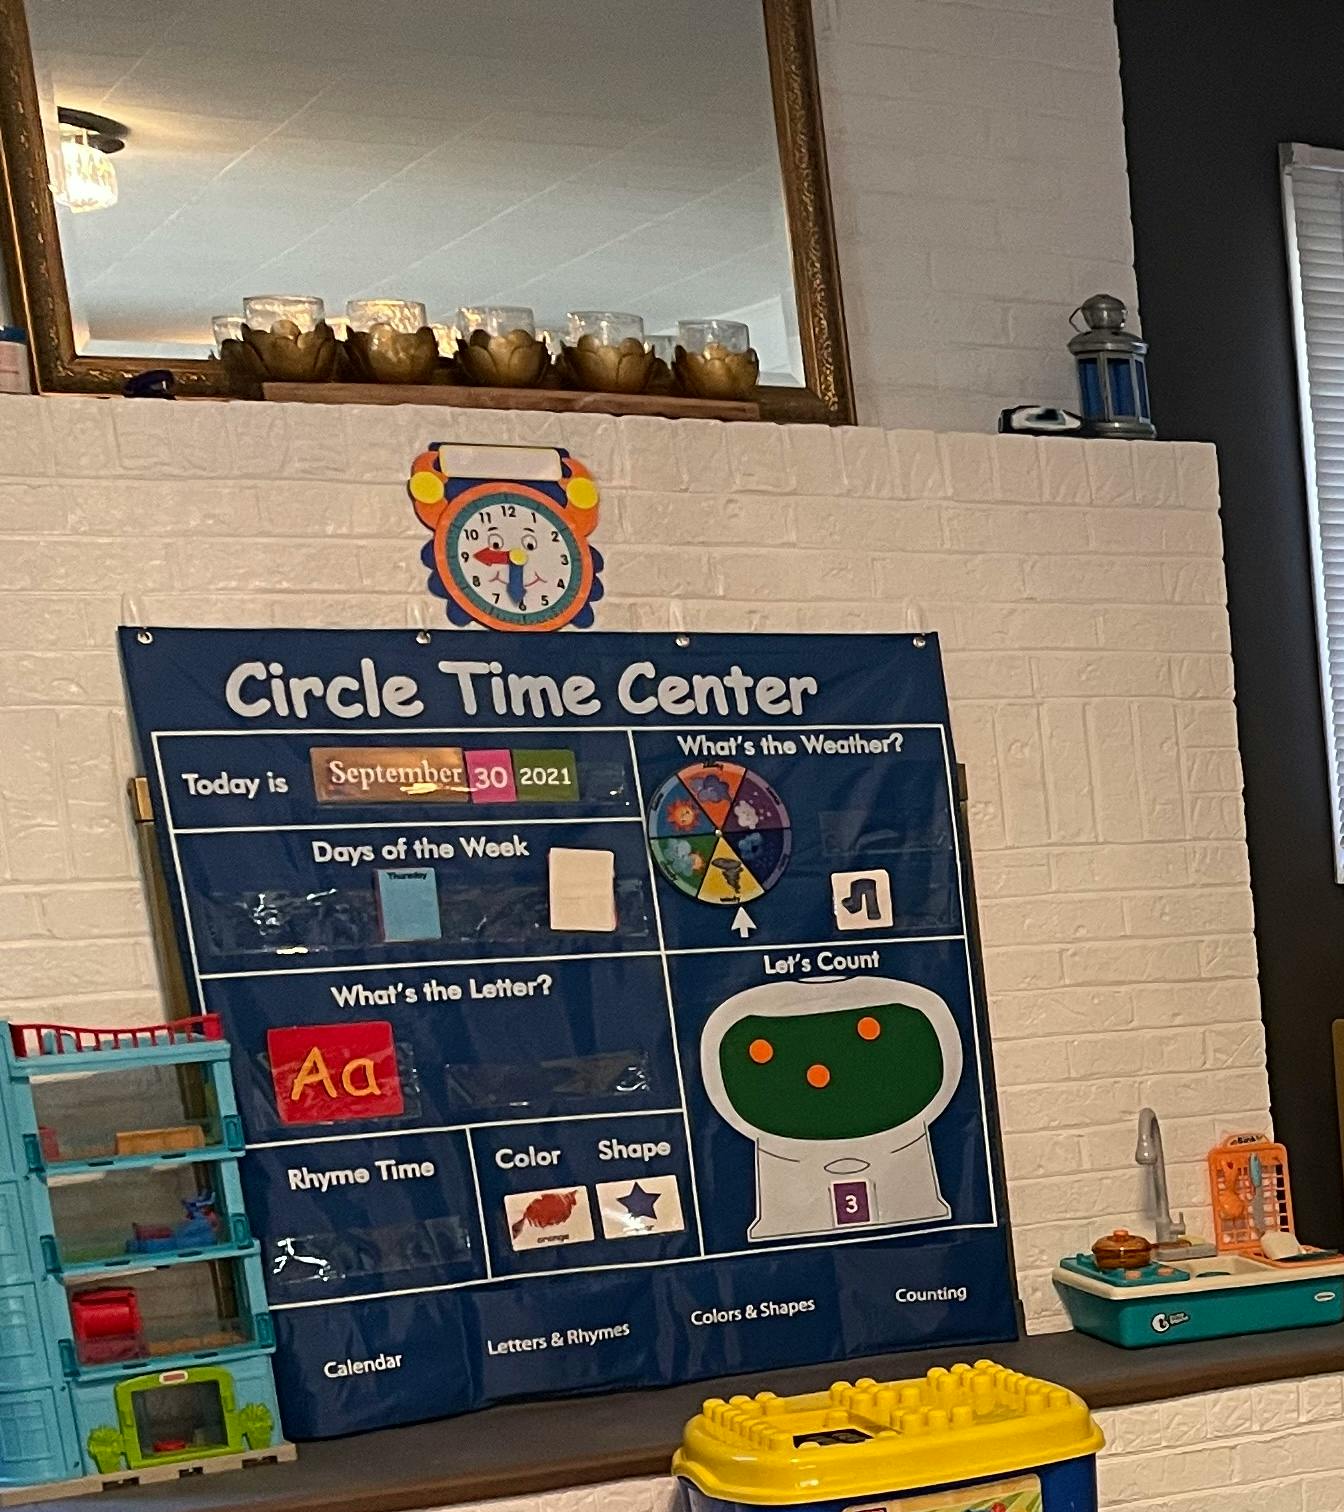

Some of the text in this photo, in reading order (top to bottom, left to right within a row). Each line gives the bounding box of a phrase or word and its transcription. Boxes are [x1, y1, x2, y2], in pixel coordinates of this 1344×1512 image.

[479, 512, 492, 524] 11
[501, 505, 516, 518] 12
[531, 512, 537, 523] 1
[463, 529, 479, 541] 10
[551, 530, 560, 542] 2
[461, 551, 469, 562] 9
[560, 554, 569, 565] 3
[472, 575, 481, 587] 8
[556, 578, 565, 589] 4
[491, 593, 500, 604] 7
[518, 597, 527, 611] 6
[540, 595, 549, 606] 5
[225, 658, 818, 718] Circle Time Center
[676, 733, 904, 756] What's the Weather?
[181, 771, 289, 799] Today is
[328, 760, 462, 790] September
[473, 766, 508, 789] 30
[519, 766, 572, 786] 2021
[311, 835, 529, 866] Days of the Week
[763, 950, 880, 975] Let's Count
[330, 974, 552, 1007] What's the Letter?
[291, 1046, 382, 1100] Aa
[495, 1139, 672, 1169] Color Shape
[287, 1159, 435, 1193] Rhyme Time
[845, 1194, 859, 1214] 3
[895, 1286, 968, 1303] Counting
[690, 1298, 816, 1326] Colors & Shapes
[487, 1321, 631, 1357] Letters & Rhymes
[323, 1353, 403, 1379] Calendar
